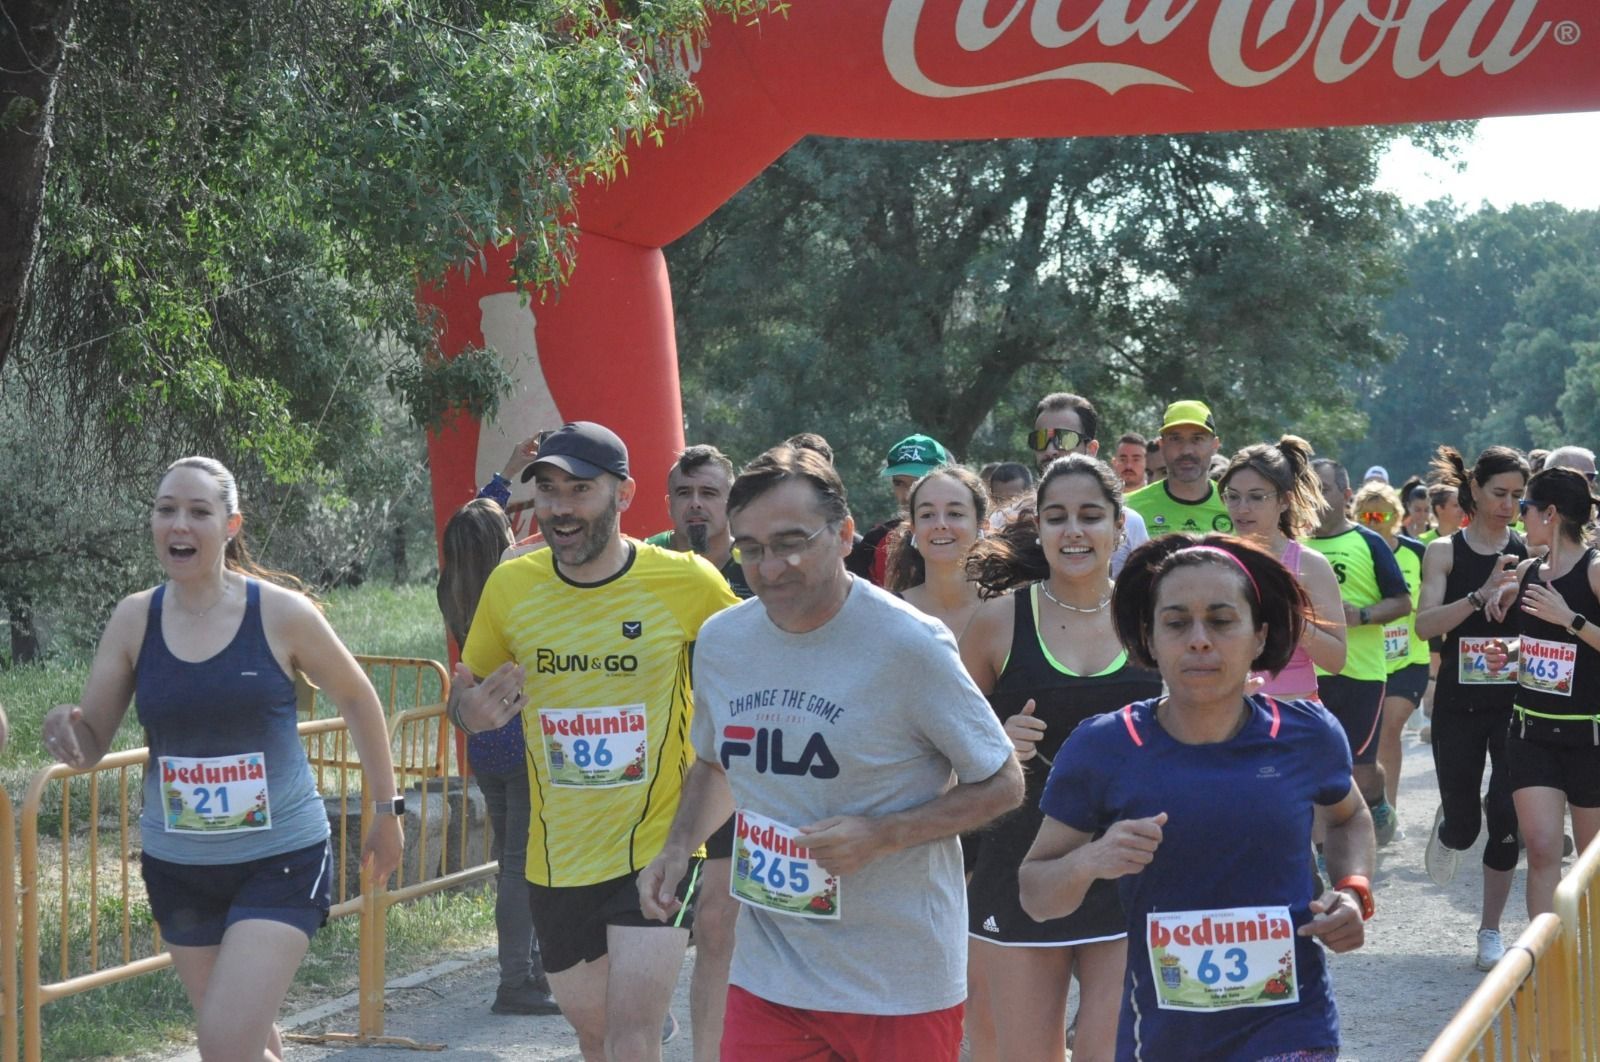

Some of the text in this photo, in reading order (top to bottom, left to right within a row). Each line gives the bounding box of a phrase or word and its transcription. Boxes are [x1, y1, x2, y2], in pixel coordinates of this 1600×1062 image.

[537, 648, 638, 675] RUN & GO
[1520, 639, 1575, 662] bedunia
[1527, 657, 1559, 679] 463
[729, 689, 845, 725] CHANGE THE GAME
[541, 711, 645, 736] bedunia
[573, 738, 613, 768] 86
[720, 725, 840, 779] FILA
[162, 760, 264, 784] bedunia
[193, 786, 229, 814] 21
[749, 849, 810, 893] 265
[1150, 913, 1291, 949] bedunia
[1197, 947, 1249, 985] 63
